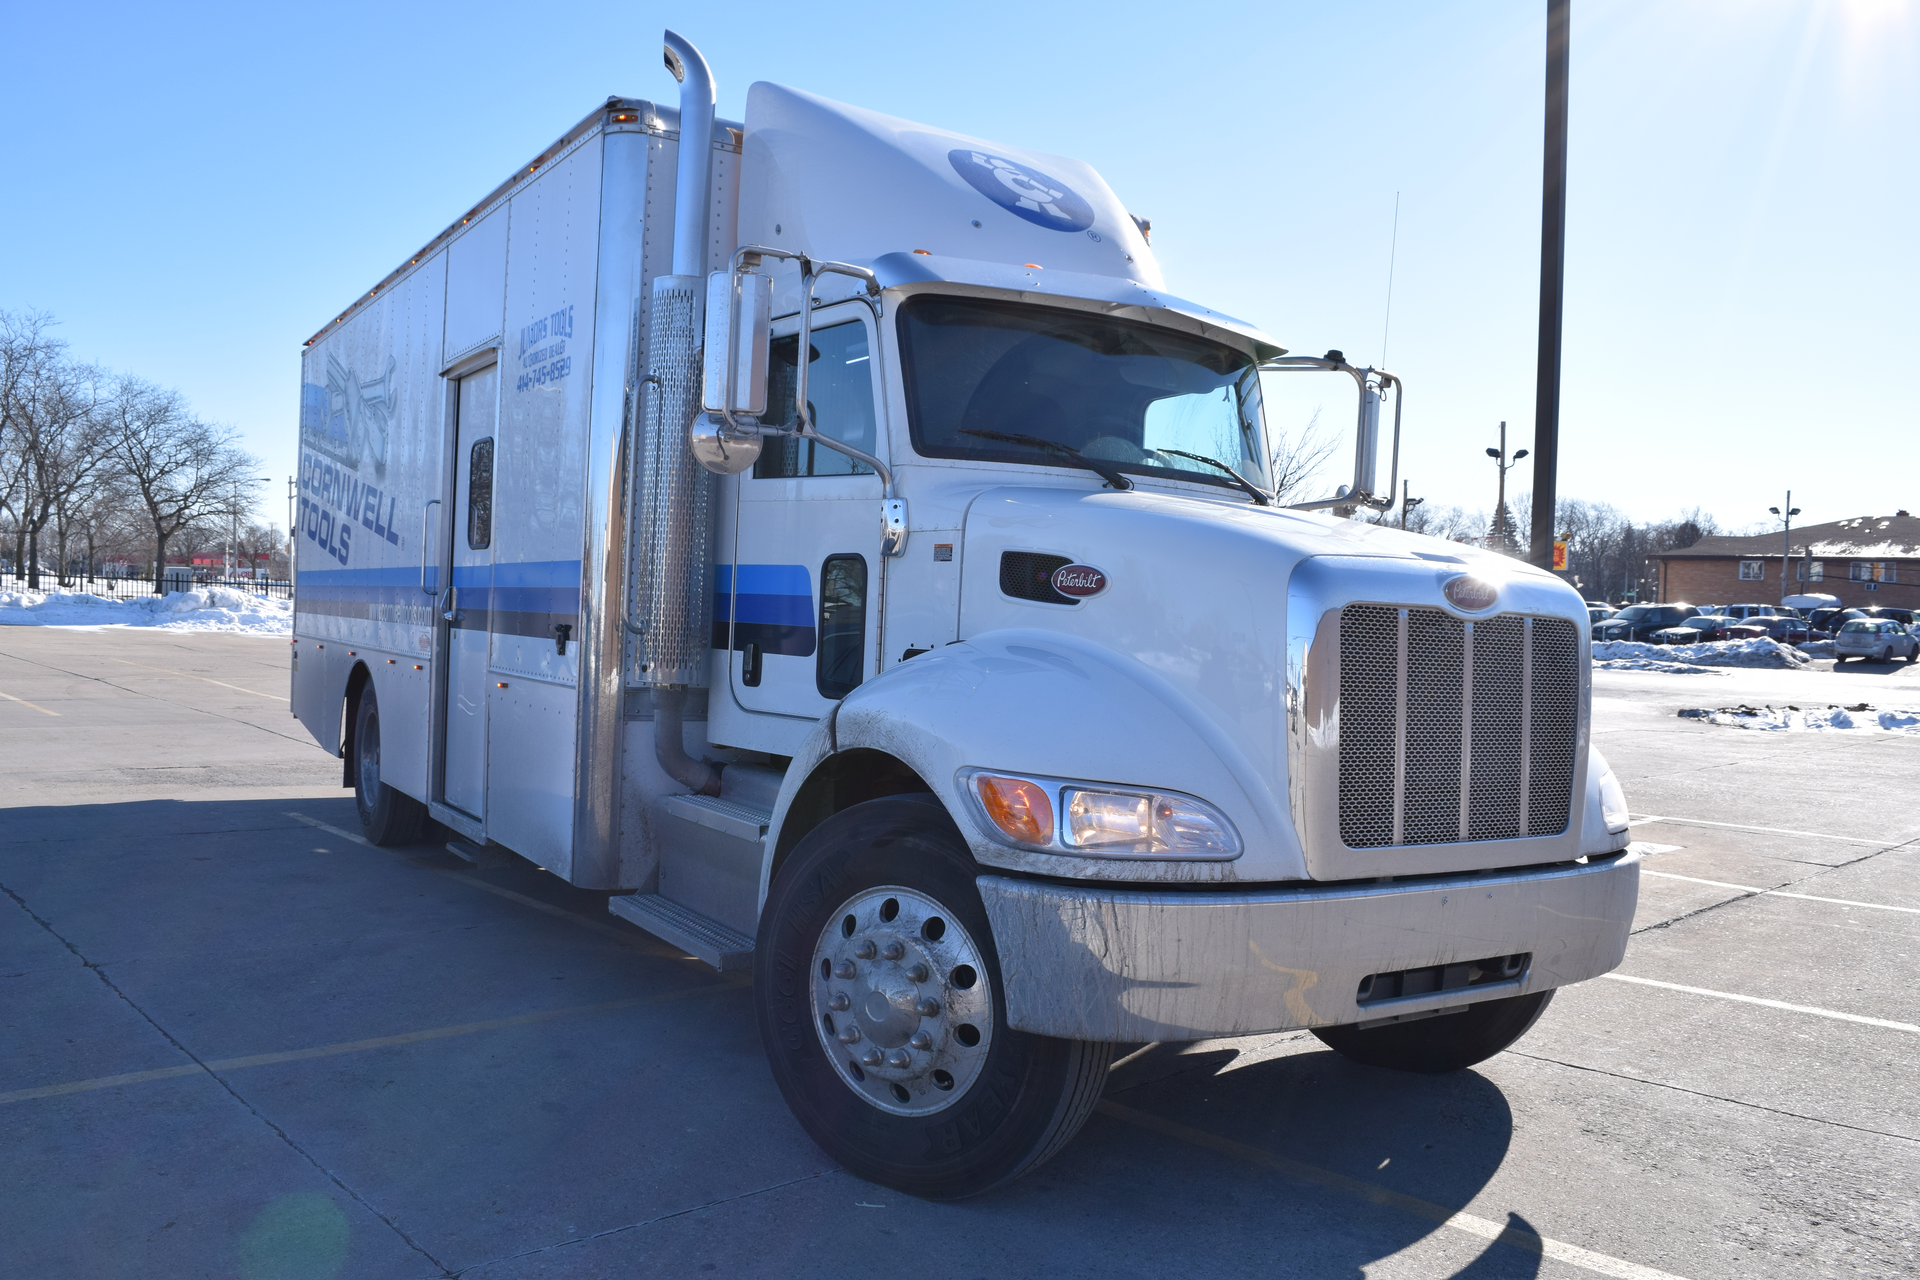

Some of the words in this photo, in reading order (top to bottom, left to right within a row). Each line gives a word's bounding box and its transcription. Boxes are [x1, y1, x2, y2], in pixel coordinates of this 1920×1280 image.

[551, 304, 574, 339] TOOLS
[517, 355, 572, 393] 414-745-8529
[302, 453, 399, 547] CORNWELL
[301, 496, 351, 566] TOOLS
[1057, 570, 1101, 588] Peterbilt
[1453, 581, 1493, 600] Peterbilt
